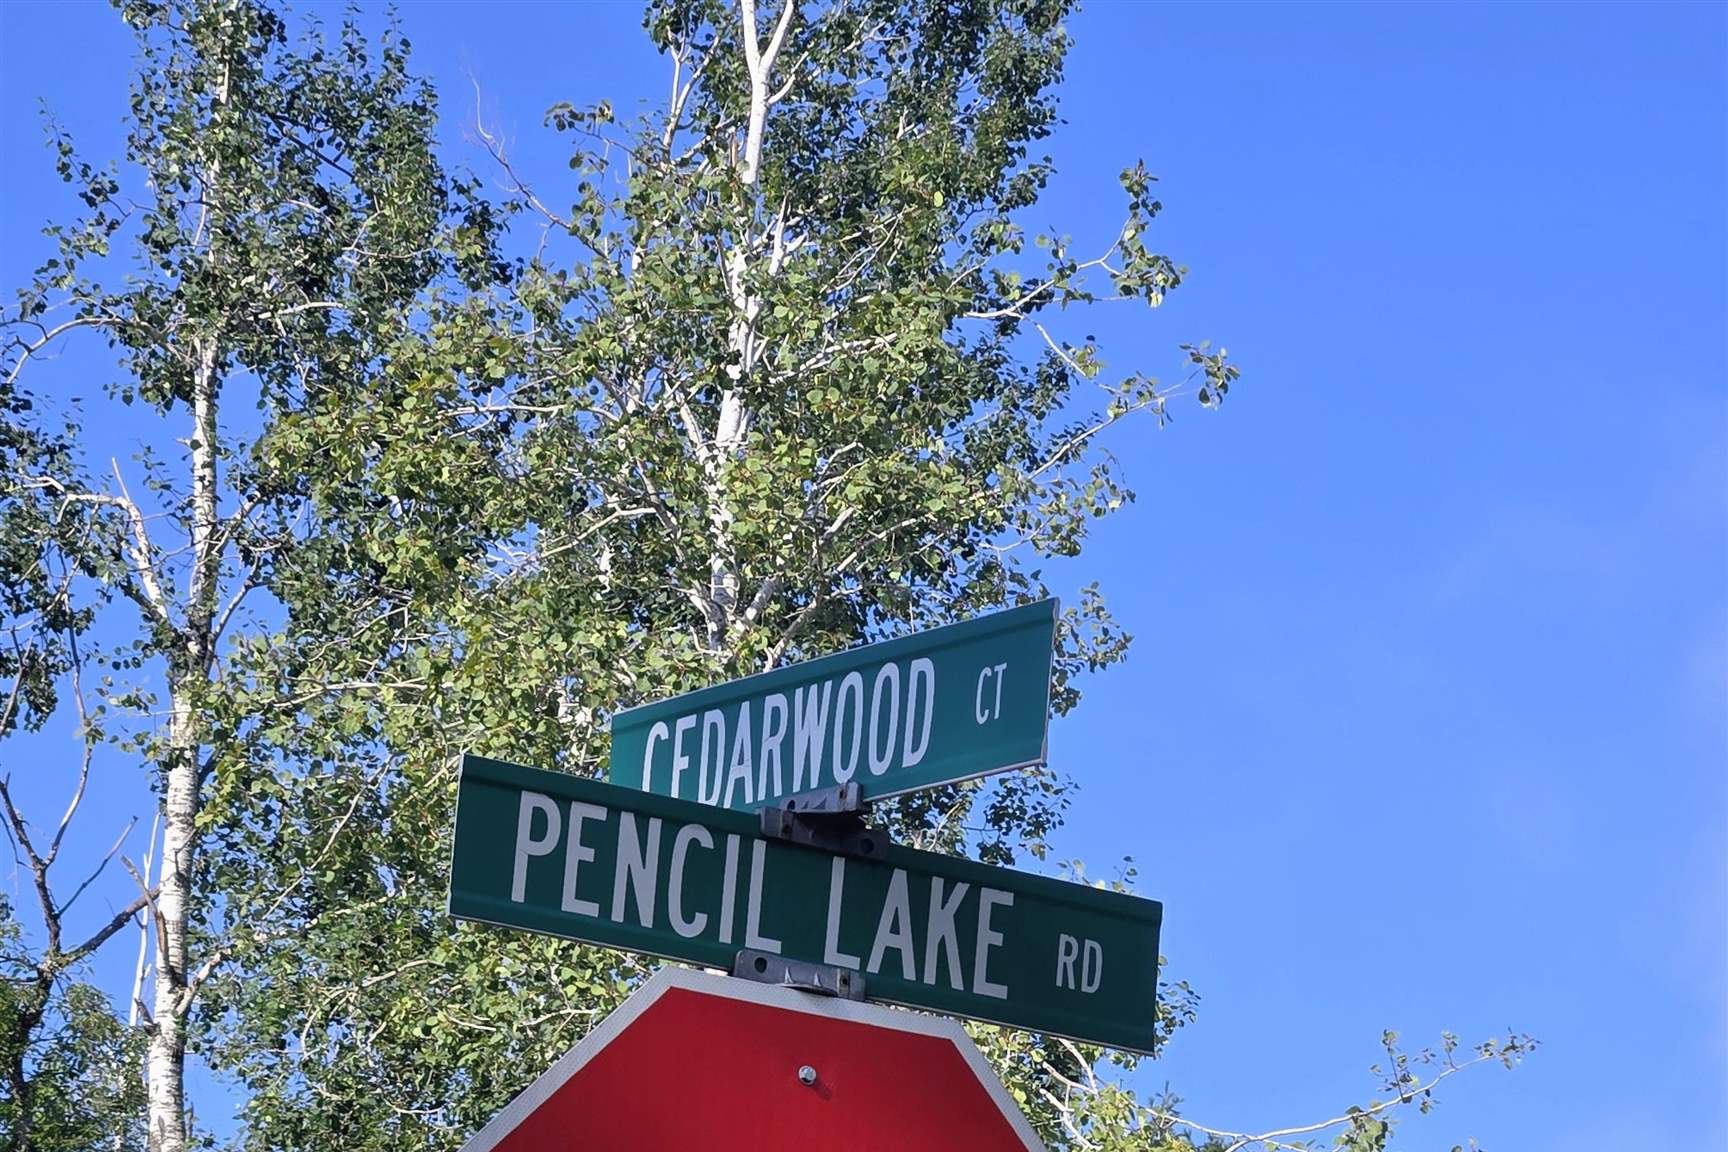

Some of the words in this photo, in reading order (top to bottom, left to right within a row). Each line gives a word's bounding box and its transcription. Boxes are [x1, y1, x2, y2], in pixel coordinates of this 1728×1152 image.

[642, 657, 936, 809] CEDARWOOD
[975, 662, 1007, 726] CT
[511, 790, 782, 954] PENCIL
[824, 856, 1015, 1000] LAKE
[1056, 933, 1103, 995] RD
